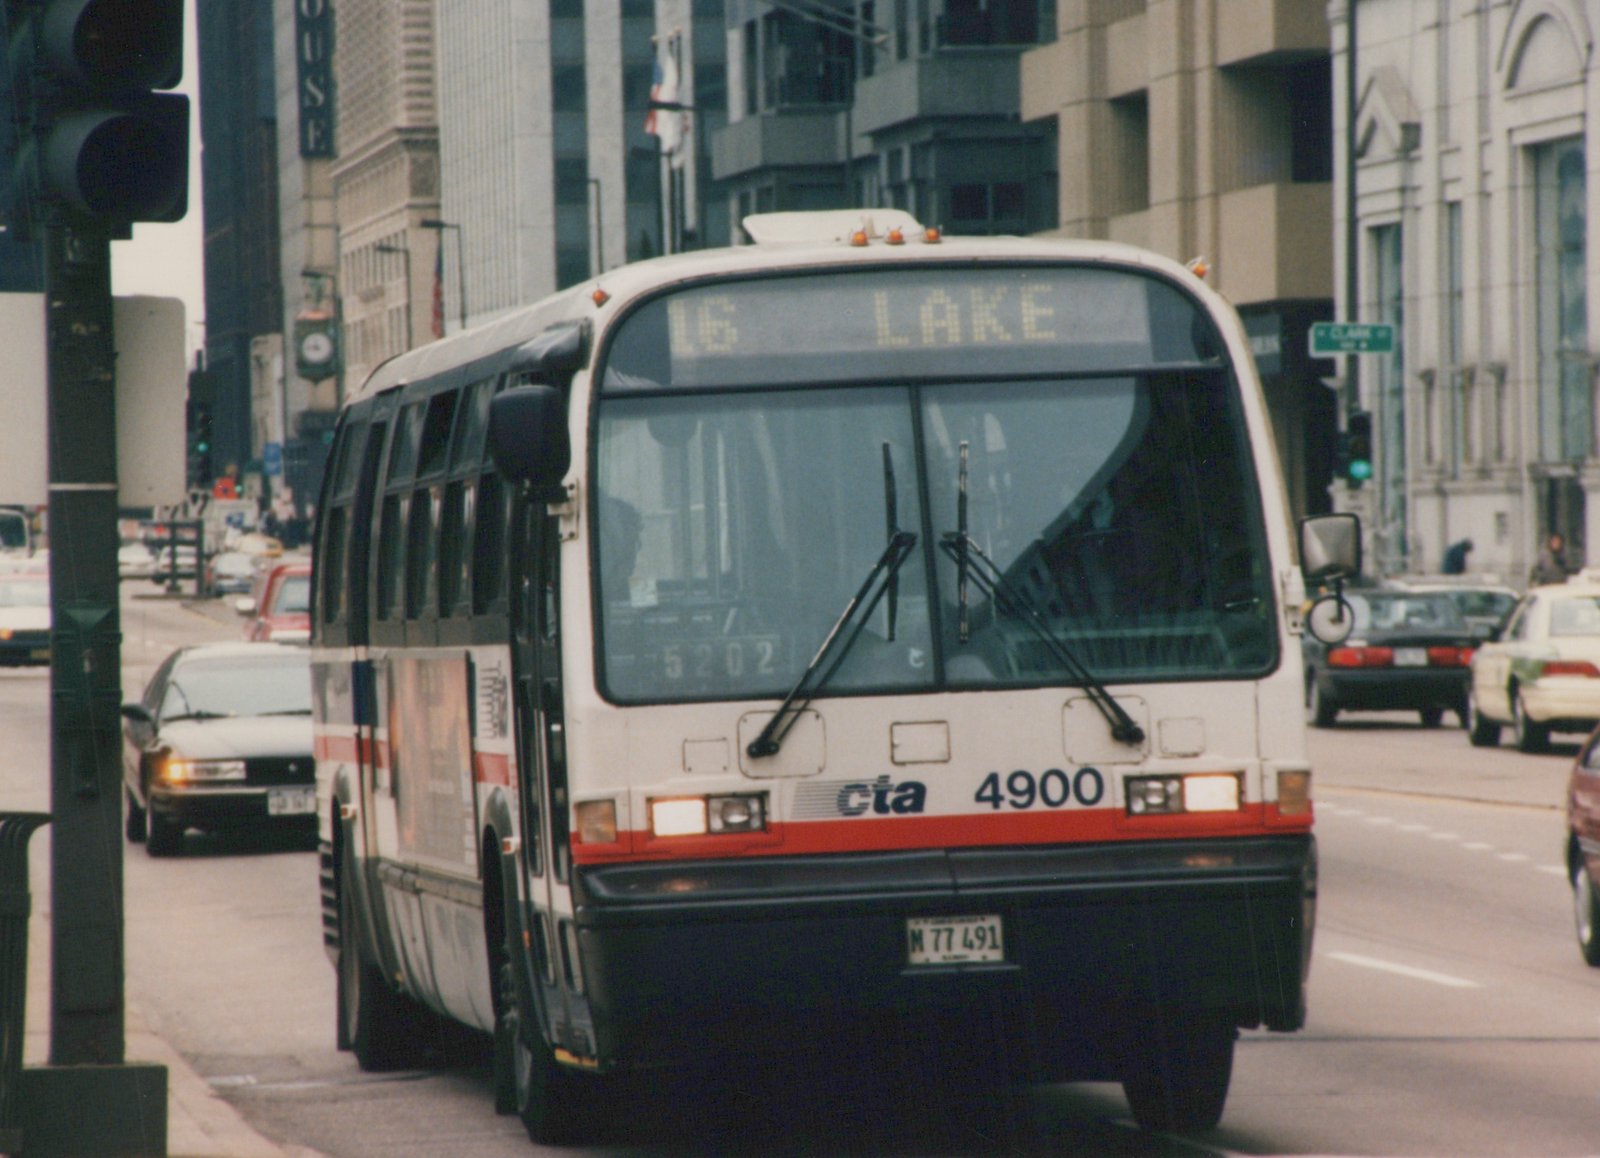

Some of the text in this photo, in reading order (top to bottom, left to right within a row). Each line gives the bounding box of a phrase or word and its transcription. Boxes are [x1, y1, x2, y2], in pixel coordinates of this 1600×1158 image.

[668, 284, 1056, 352] 16 LAKE
[836, 767, 1104, 816] cta 4900
[931, 927, 954, 952] 77
[962, 925, 1000, 950] 491
